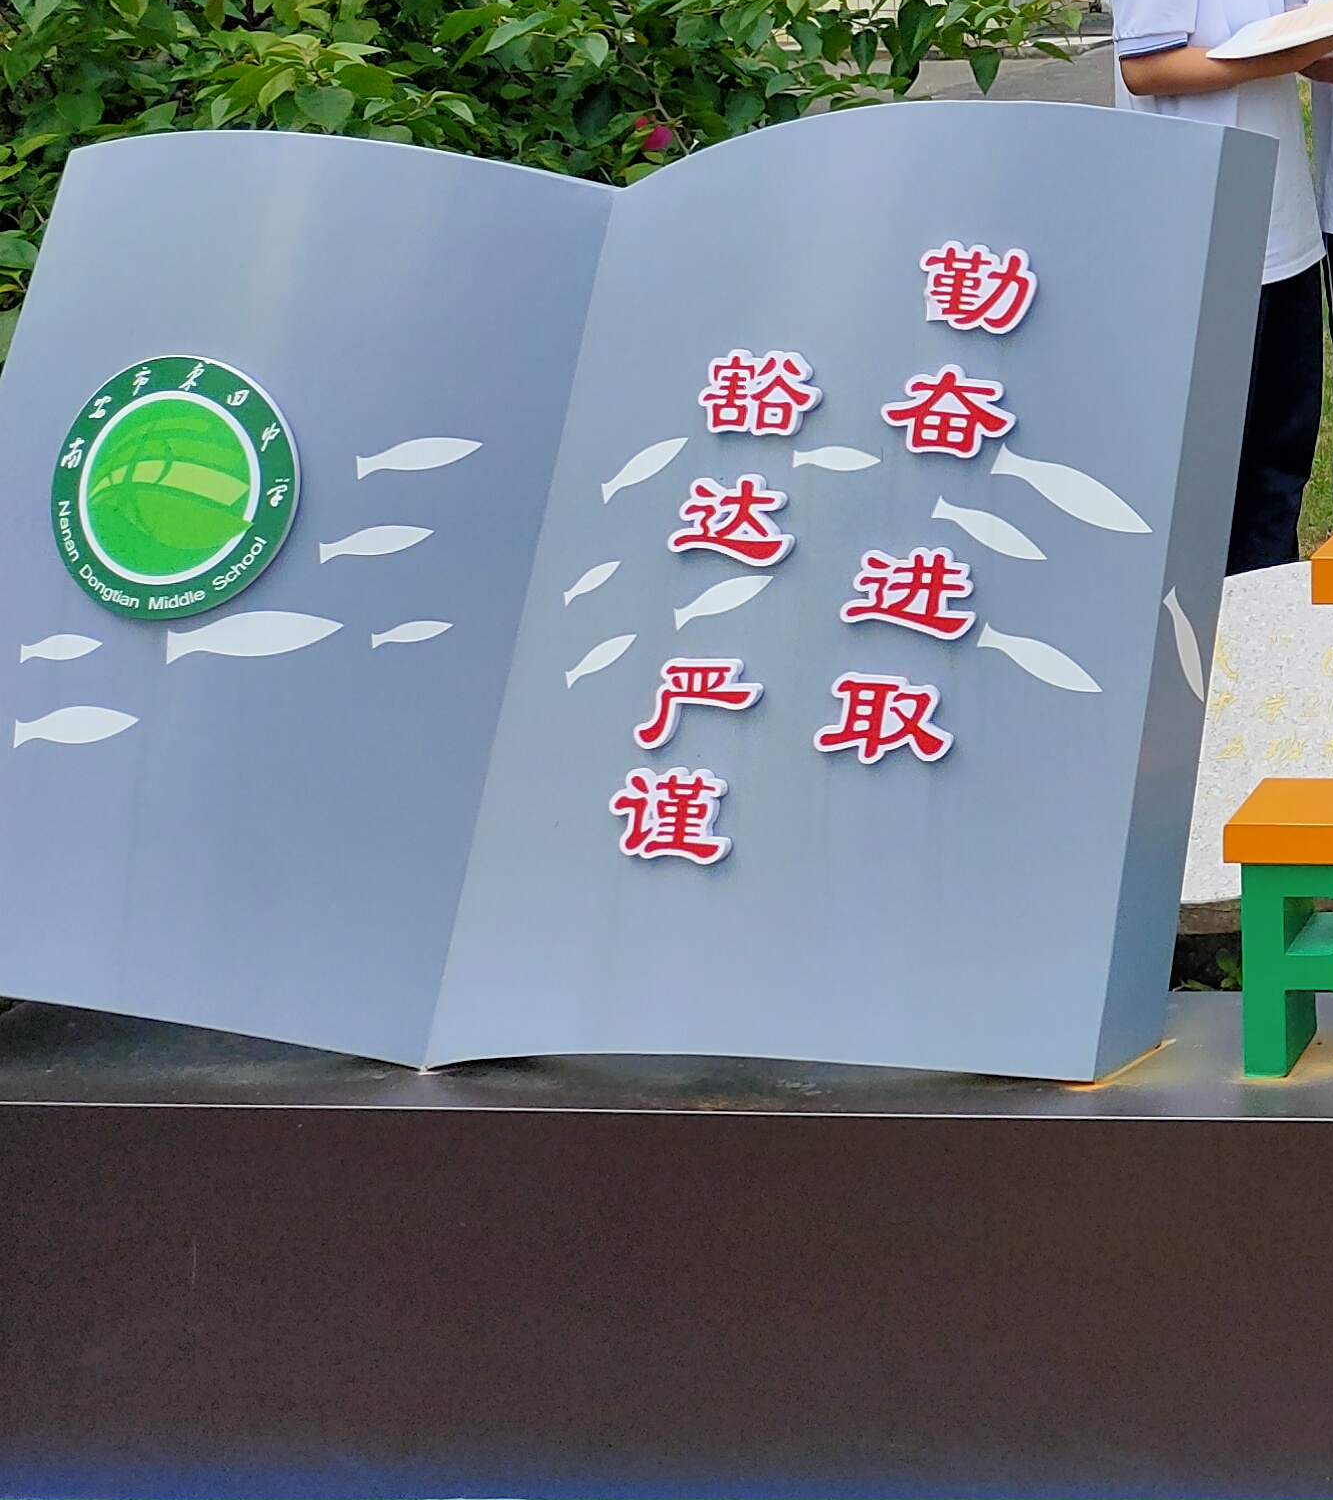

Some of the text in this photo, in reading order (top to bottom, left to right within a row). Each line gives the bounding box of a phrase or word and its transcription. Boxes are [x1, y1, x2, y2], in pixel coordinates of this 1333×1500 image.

[58, 500, 267, 610] Nanan Dongtian Middle School
[611, 351, 817, 863] 豁达 严谨
[817, 242, 1036, 763] 勤奋 进取
